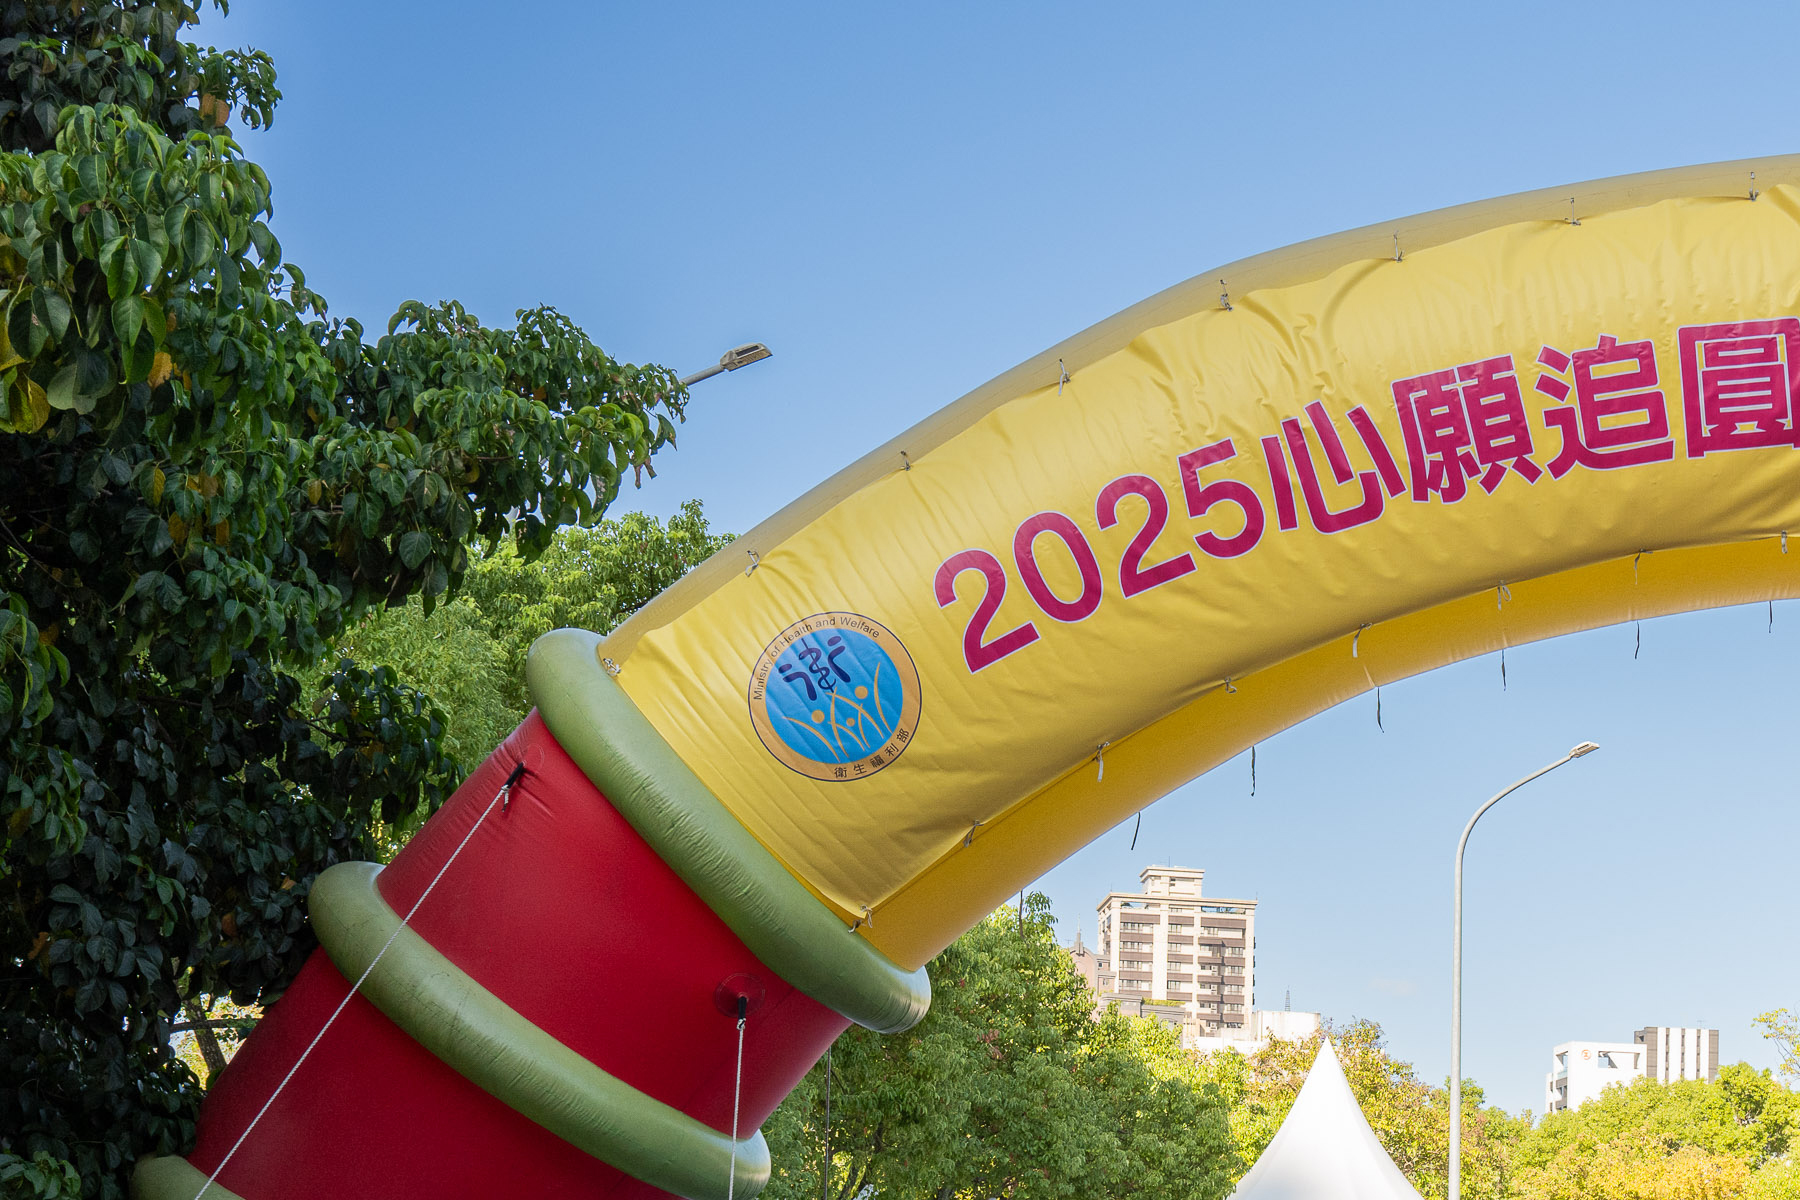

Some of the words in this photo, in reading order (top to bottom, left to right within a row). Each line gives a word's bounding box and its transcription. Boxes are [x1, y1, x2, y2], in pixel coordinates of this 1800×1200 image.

[753, 659, 774, 700] Ministry
[771, 644, 782, 658] of
[779, 623, 813, 647] Health
[815, 616, 836, 628] and
[840, 616, 881, 639] Welfare
[834, 728, 910, 779] 衛生福利部
